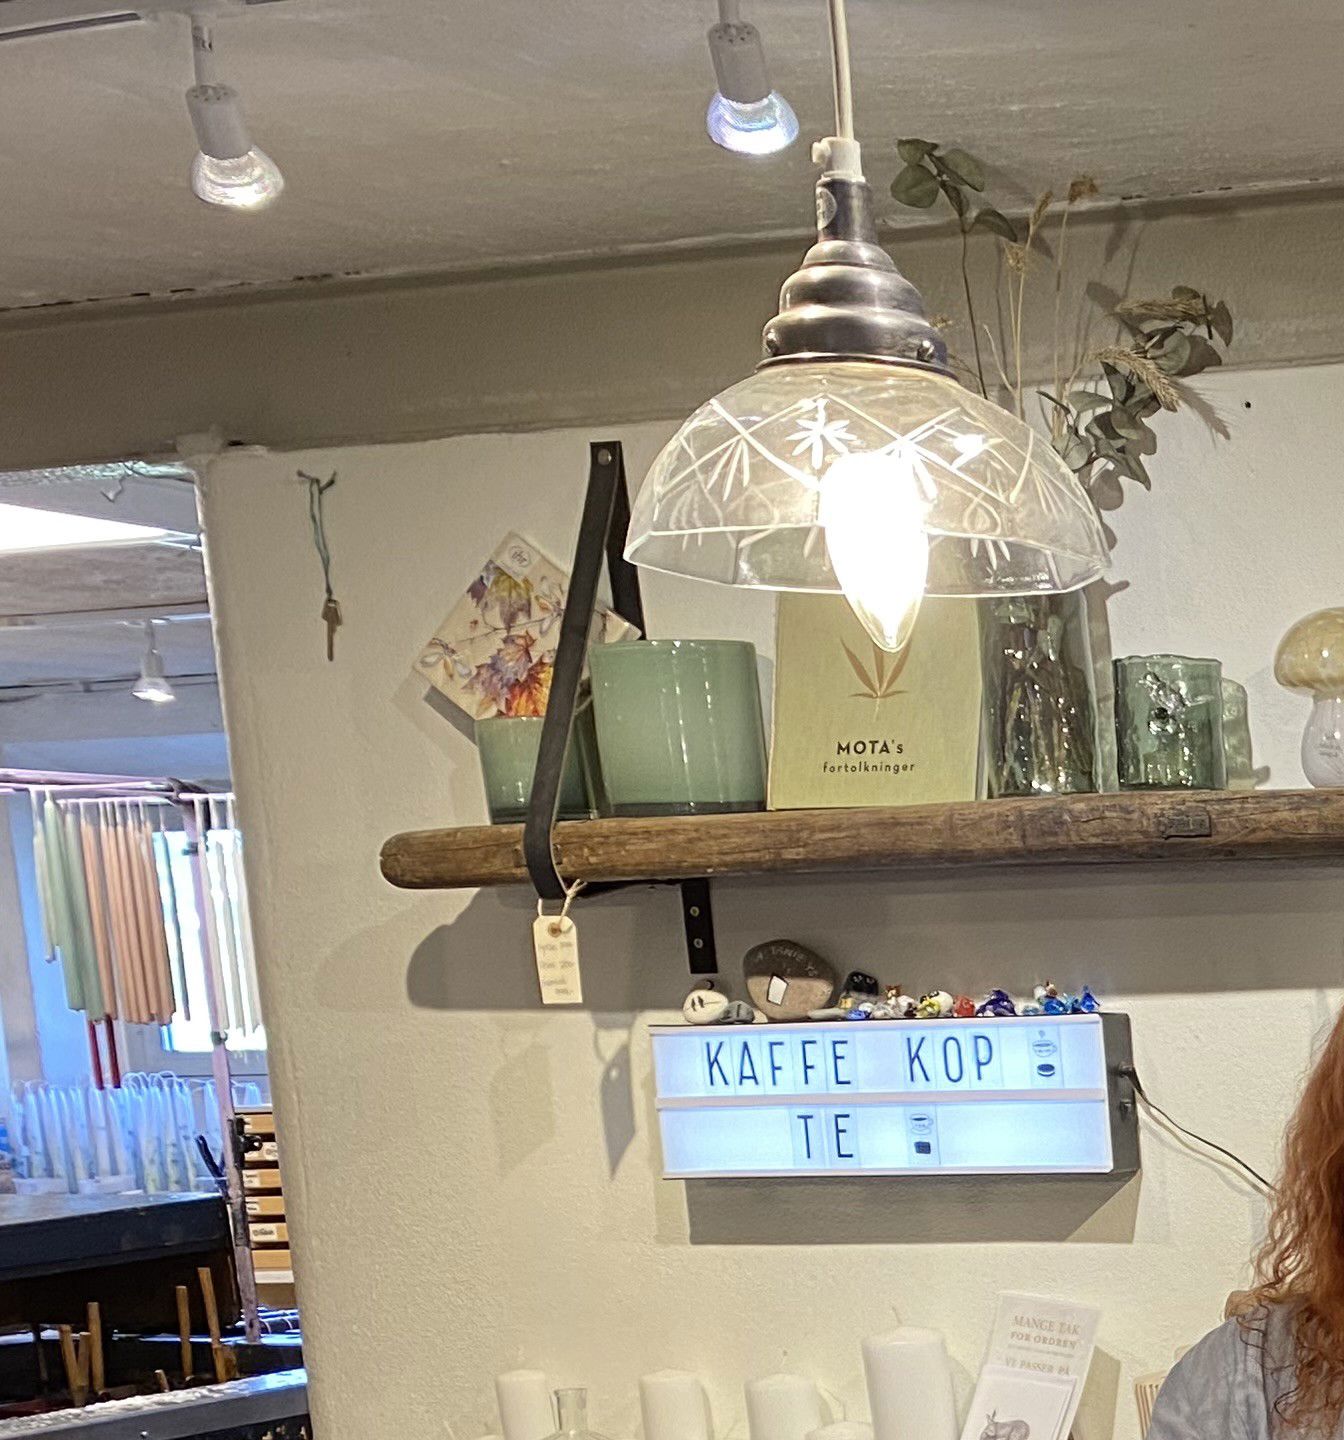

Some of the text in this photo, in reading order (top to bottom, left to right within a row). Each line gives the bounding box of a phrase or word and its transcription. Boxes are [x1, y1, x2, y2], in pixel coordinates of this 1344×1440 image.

[836, 739, 905, 756] MOTA's
[823, 761, 916, 775] fortolkninger
[704, 1035, 993, 1087] KAFFE KOP
[797, 1114, 854, 1159] TE
